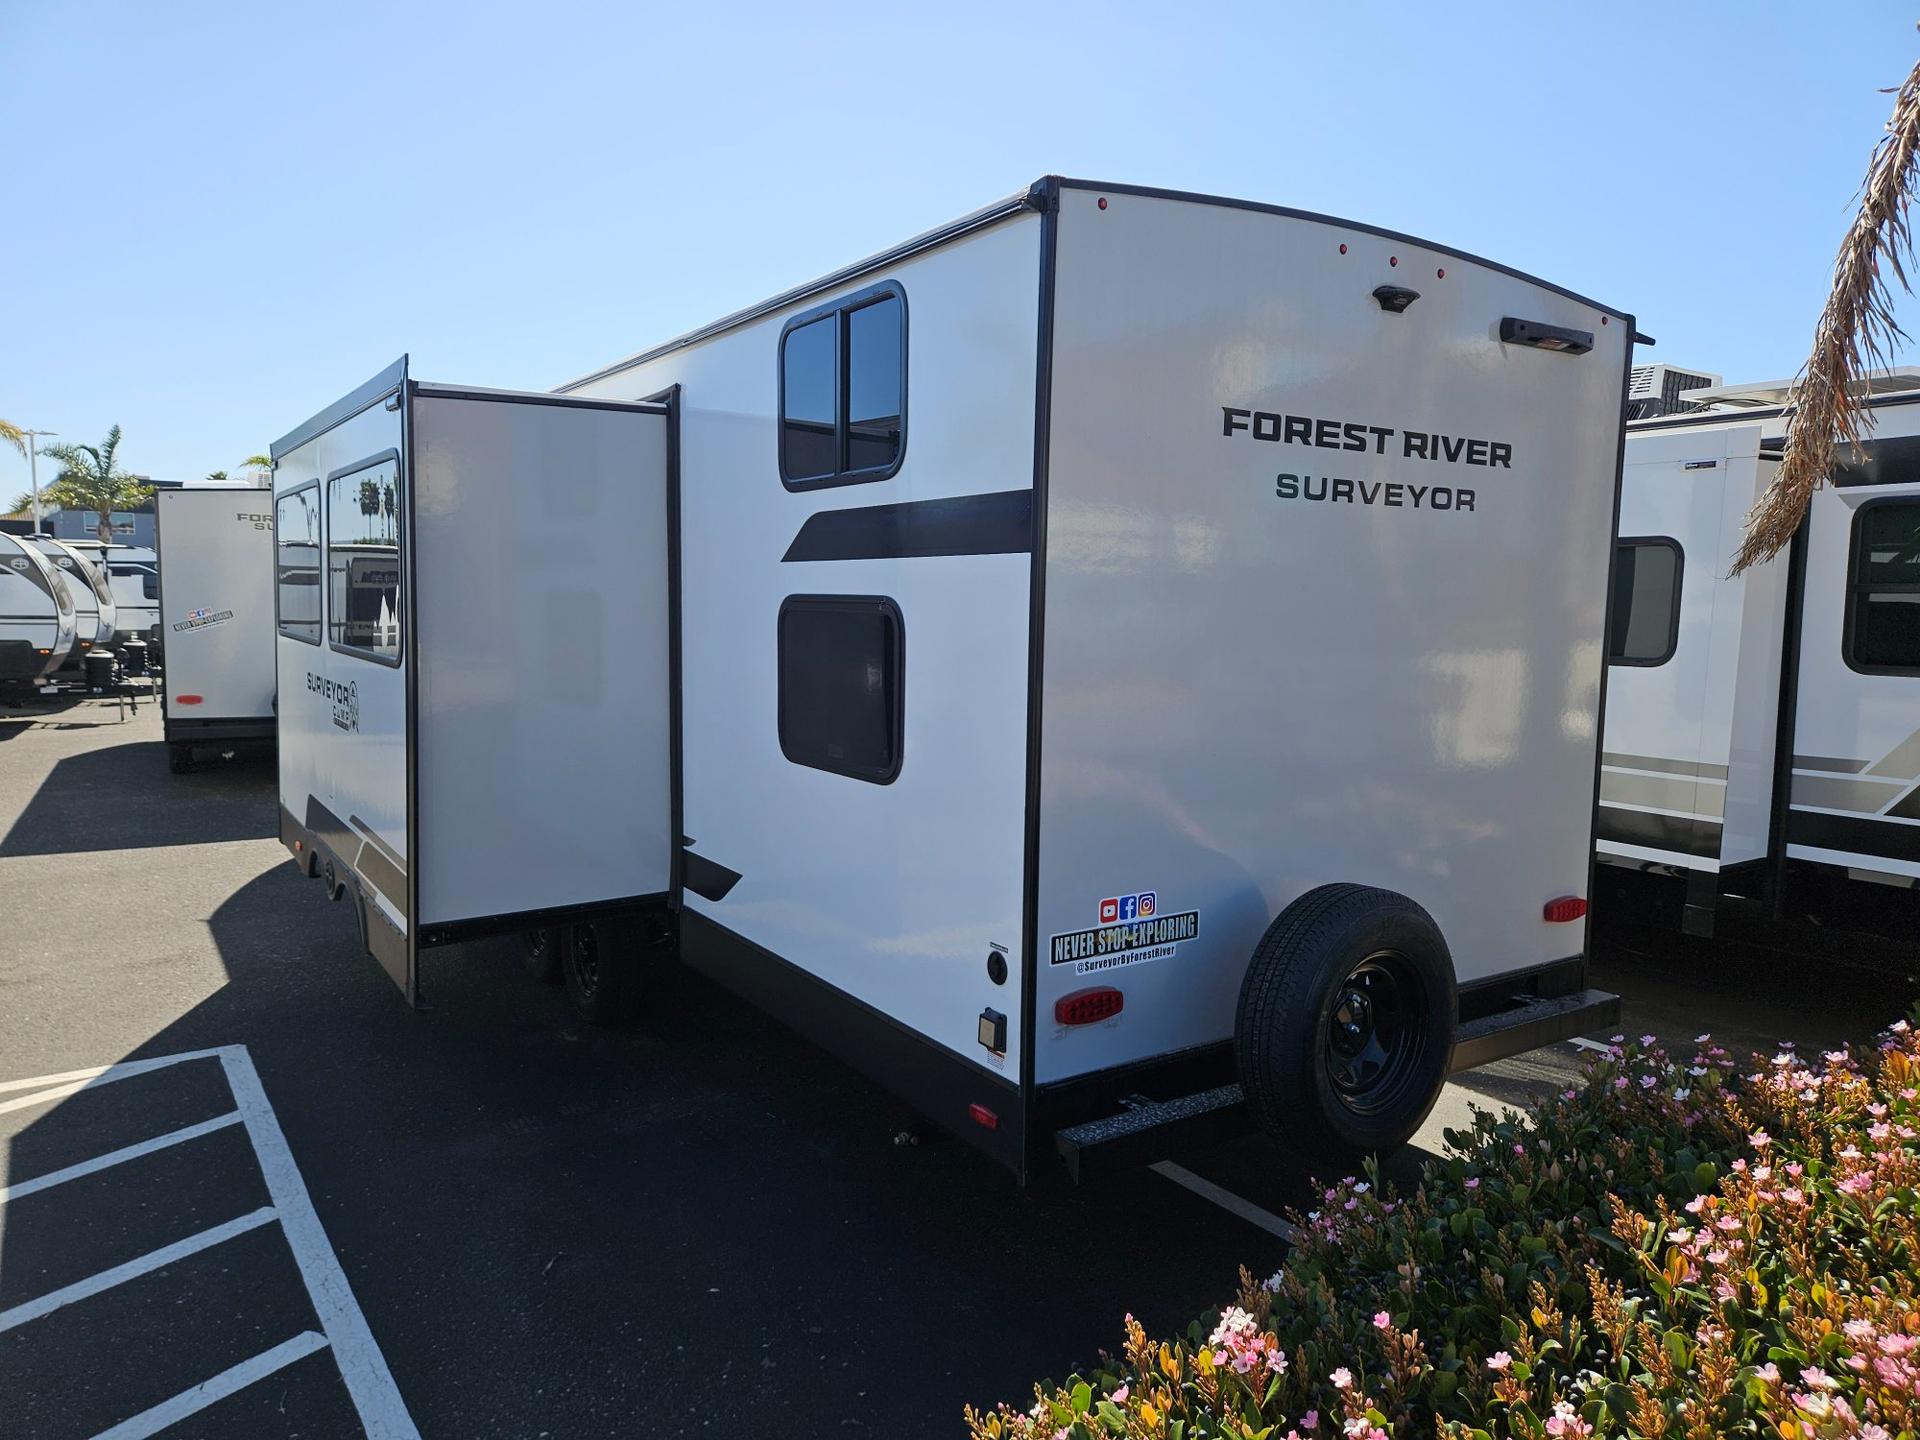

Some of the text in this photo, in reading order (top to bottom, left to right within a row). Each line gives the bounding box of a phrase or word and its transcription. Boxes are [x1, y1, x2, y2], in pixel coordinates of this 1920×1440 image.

[1222, 407, 1512, 469] FOREST RIVER
[1276, 473, 1476, 512] SURVEYOR
[306, 672, 350, 707] SURVEYOR
[1055, 914, 1196, 962] NEVER STOP EXPLORING
[1077, 946, 1175, 973] @SurveyorByForestRiver
